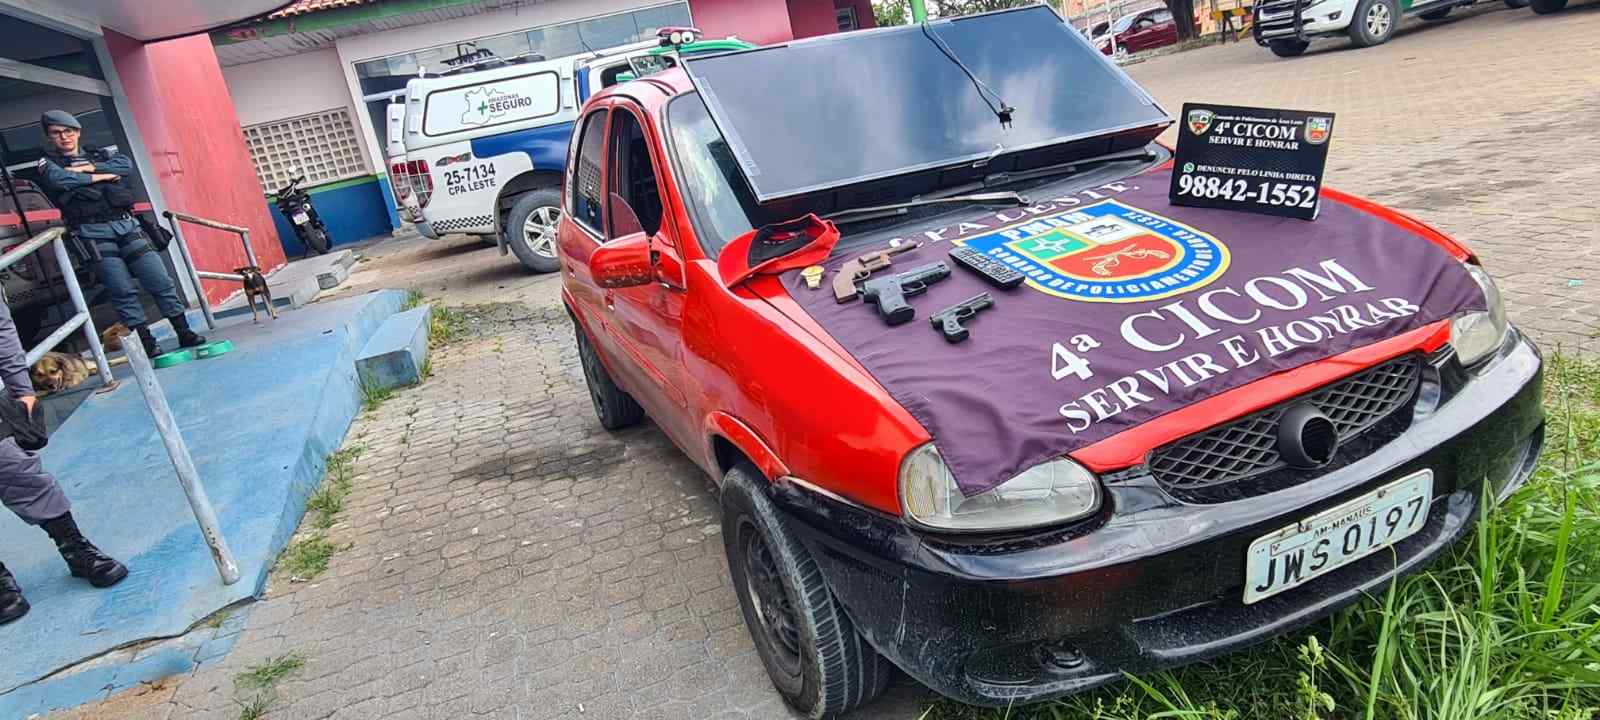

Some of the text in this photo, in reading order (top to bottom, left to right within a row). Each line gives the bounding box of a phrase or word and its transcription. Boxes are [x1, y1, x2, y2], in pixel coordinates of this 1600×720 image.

[490, 97, 532, 113] SEGURO
[1208, 135, 1299, 150] SERVIR E HONRAR
[1214, 121, 1297, 140] 4ª CICOM
[444, 162, 496, 186] 25-7134
[449, 178, 496, 195] CPA LESTE
[1197, 165, 1316, 182] DENUNCIE PELO LINHA DIRETA
[1177, 174, 1316, 208] 98842-1552
[999, 211, 1096, 240] PMAM
[1074, 259, 1211, 294] POLICIAMENTO
[1050, 258, 1375, 381] 4ª CICOM
[1059, 297, 1421, 434] SERVIR E HONRAR
[1255, 495, 1425, 593] JWS 0197
